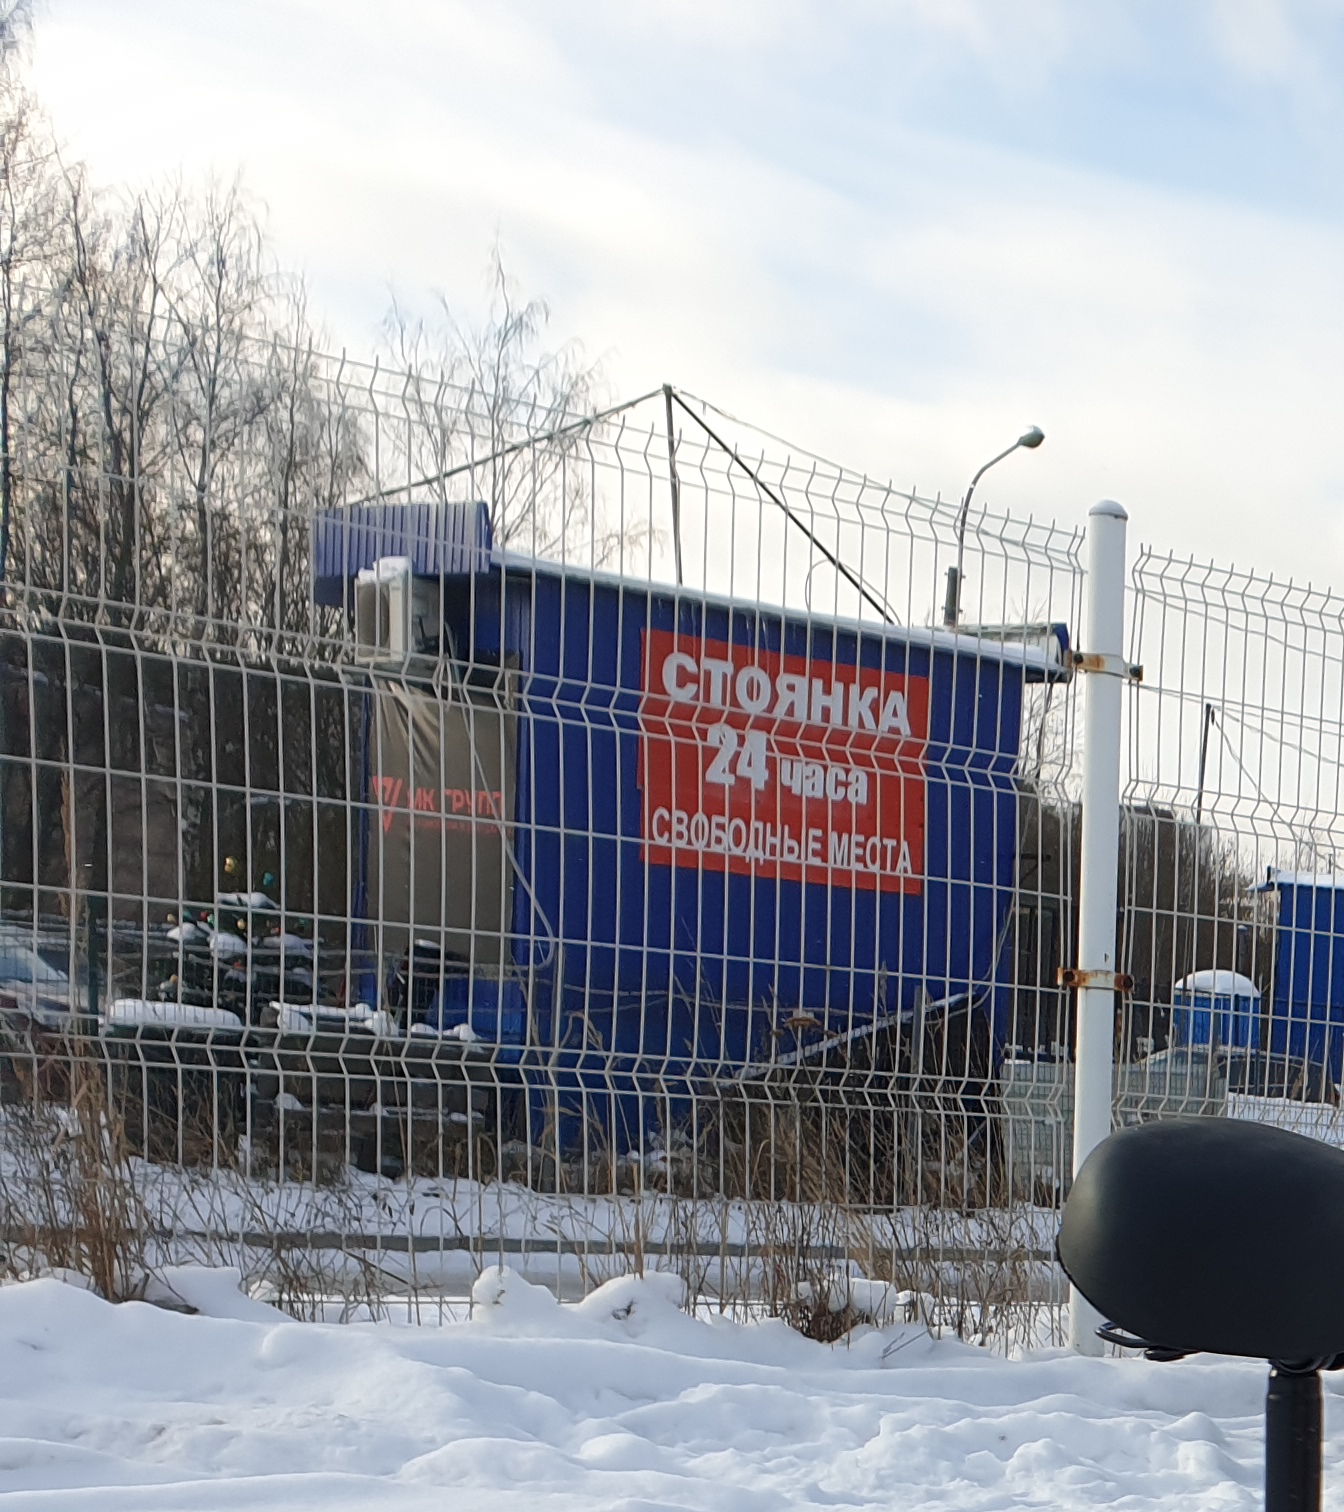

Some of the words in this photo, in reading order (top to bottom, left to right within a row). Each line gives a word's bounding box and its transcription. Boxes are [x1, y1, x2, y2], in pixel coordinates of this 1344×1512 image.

[662, 652, 912, 737] СТОЯНКА
[705, 723, 769, 791] 24
[780, 759, 868, 806] часа
[652, 806, 823, 867] СВОБОДНЫЕ
[830, 830, 913, 875] МЕСТА
